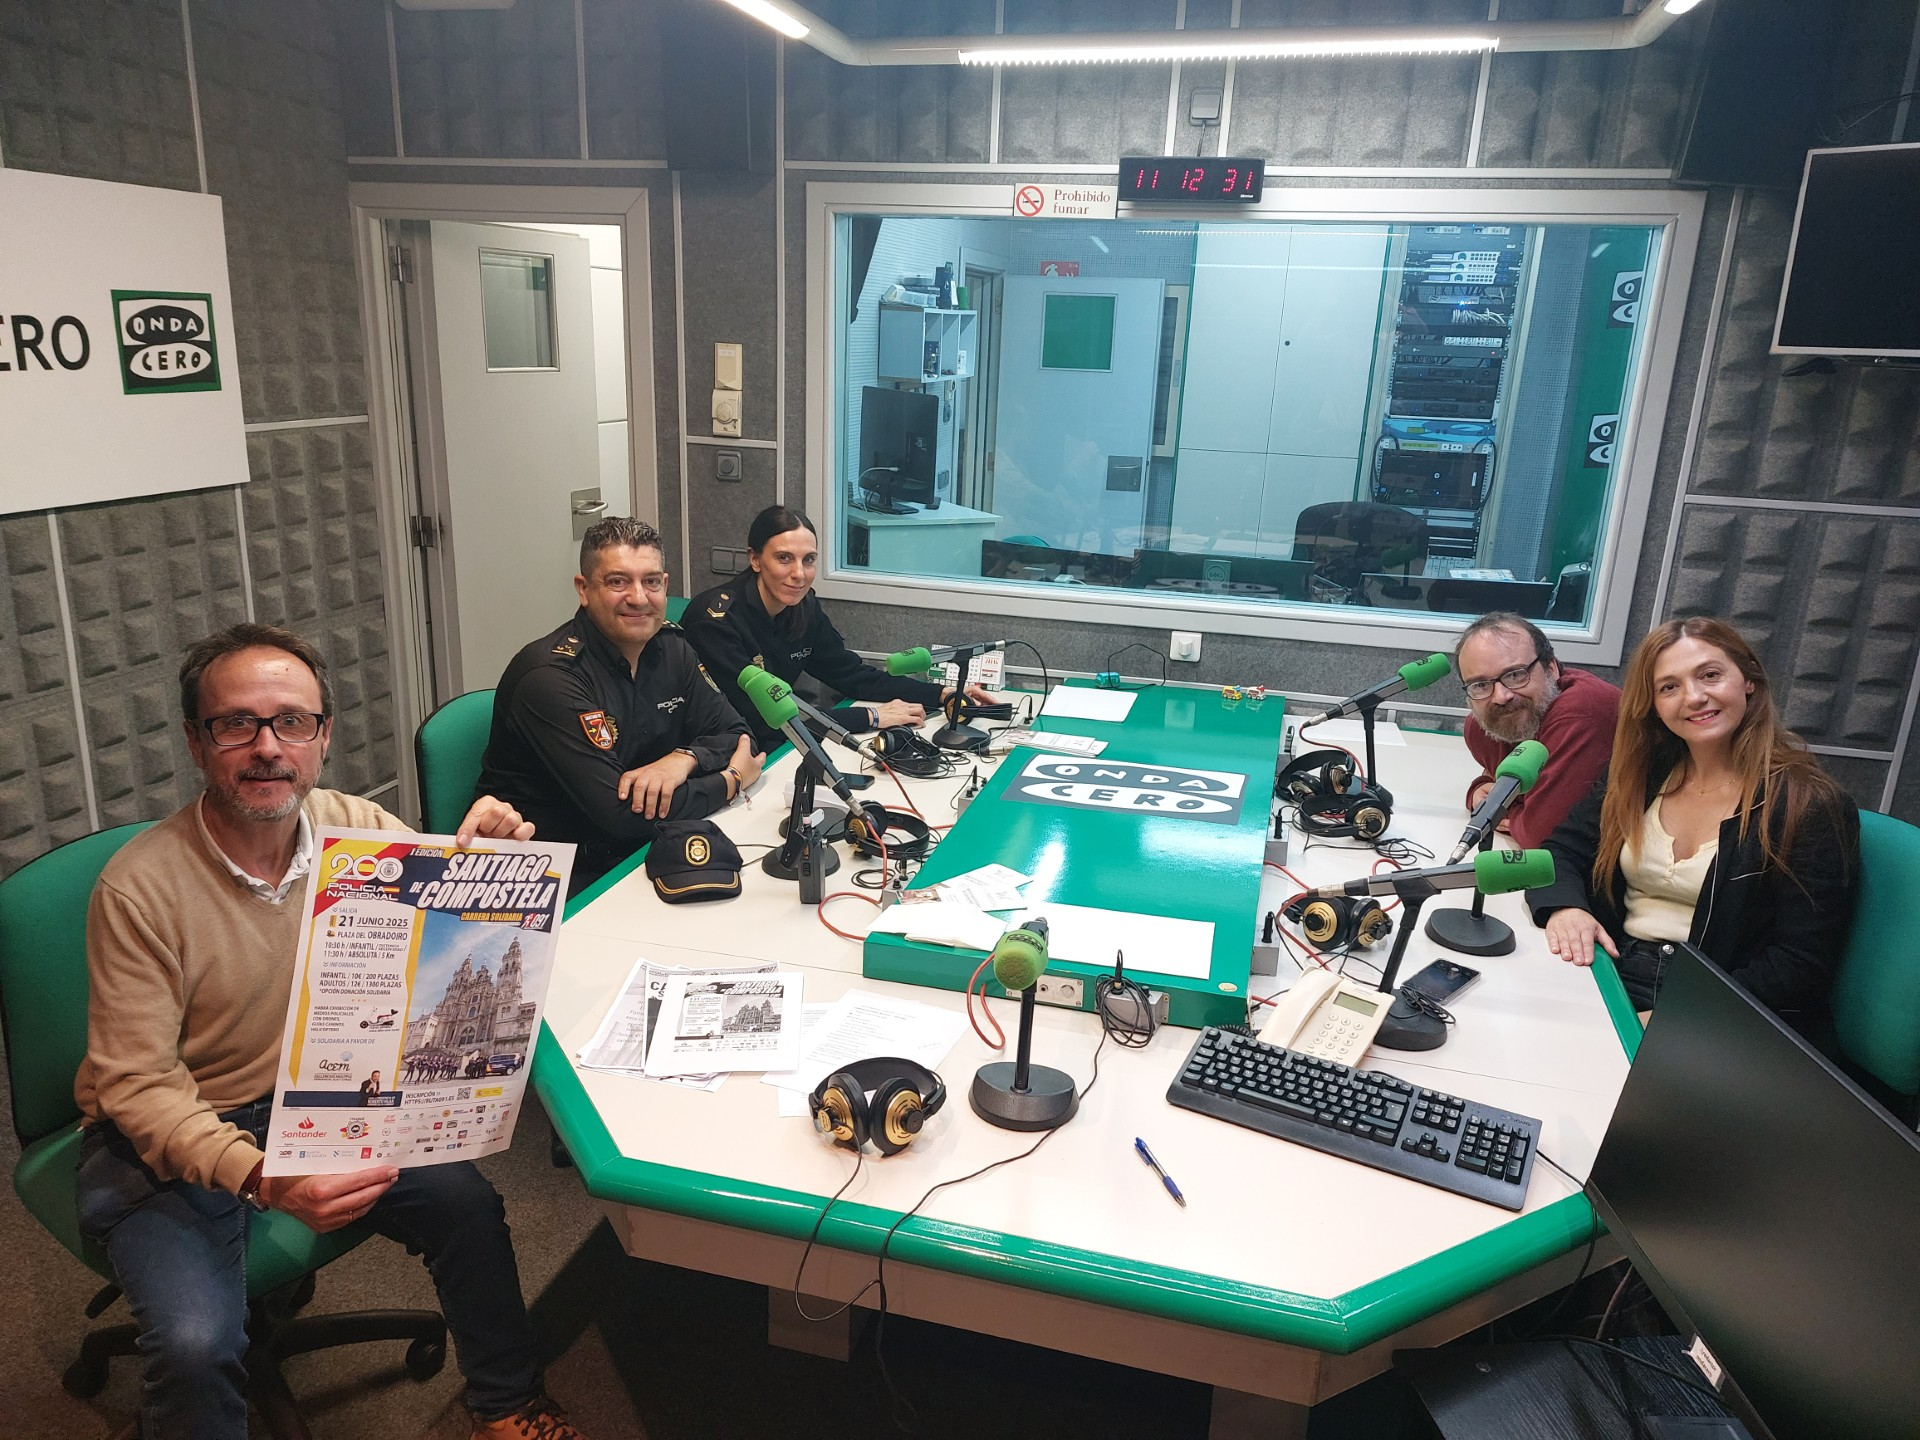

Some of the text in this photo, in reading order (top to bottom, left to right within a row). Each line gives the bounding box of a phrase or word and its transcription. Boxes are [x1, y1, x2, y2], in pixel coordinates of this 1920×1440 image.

[1136, 168, 1254, 192] 11 12 31
[1053, 188, 1111, 204] Prohibido
[1053, 203, 1090, 215] fumar
[132, 315, 199, 336] ONDA
[141, 349, 201, 372] CERO
[1054, 764, 1209, 790] ONDA
[1050, 784, 1205, 810] CERO
[329, 853, 404, 883] 200
[442, 853, 551, 882] SANTIAGO
[326, 890, 399, 901] NACIONAL
[409, 881, 558, 909] DE COMPOSTELA
[338, 915, 408, 927] 21 JUNIO 2025
[460, 912, 490, 921] CARRERA
[490, 912, 523, 921] SOLIDARIA
[337, 931, 355, 939] PLAZA
[367, 931, 408, 940] OBRADOIRO
[349, 942, 374, 951] INFANTIL
[324, 950, 339, 958] 11:30
[347, 951, 378, 959] ABSOLUTA
[377, 973, 399, 981] PLAZAS
[405, 1090, 436, 1099] INSCRIPCIÓN
[281, 1130, 327, 1139] Santander
